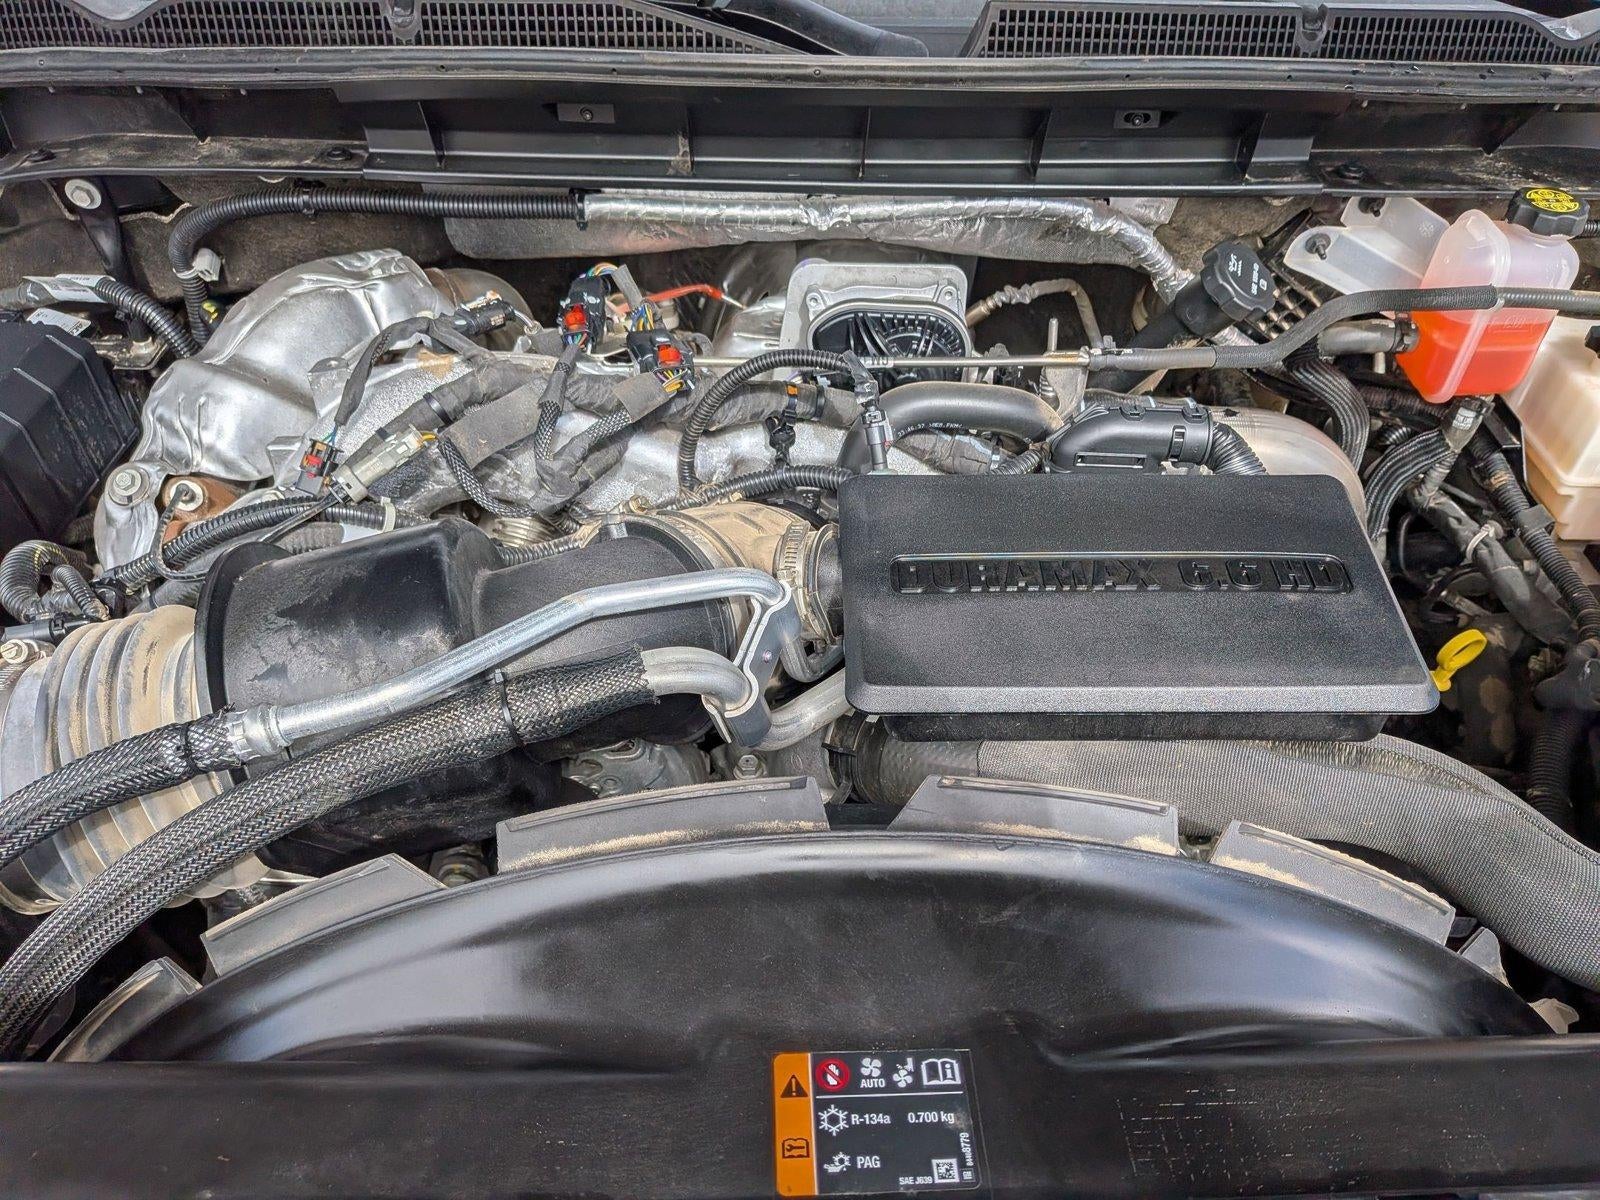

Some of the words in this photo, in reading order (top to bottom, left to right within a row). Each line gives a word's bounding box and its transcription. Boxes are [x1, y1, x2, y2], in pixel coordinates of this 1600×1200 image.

[897, 558, 1162, 593] DURAMAX
[1177, 559, 1264, 591] 6.6
[1269, 558, 1348, 592] HD
[860, 1078, 885, 1088] AUTO
[851, 1112, 891, 1125] R-134a
[907, 1112, 938, 1123] 0.700
[940, 1111, 955, 1124] kg
[857, 1156, 881, 1169] PAG
[899, 1176, 915, 1185] SAE
